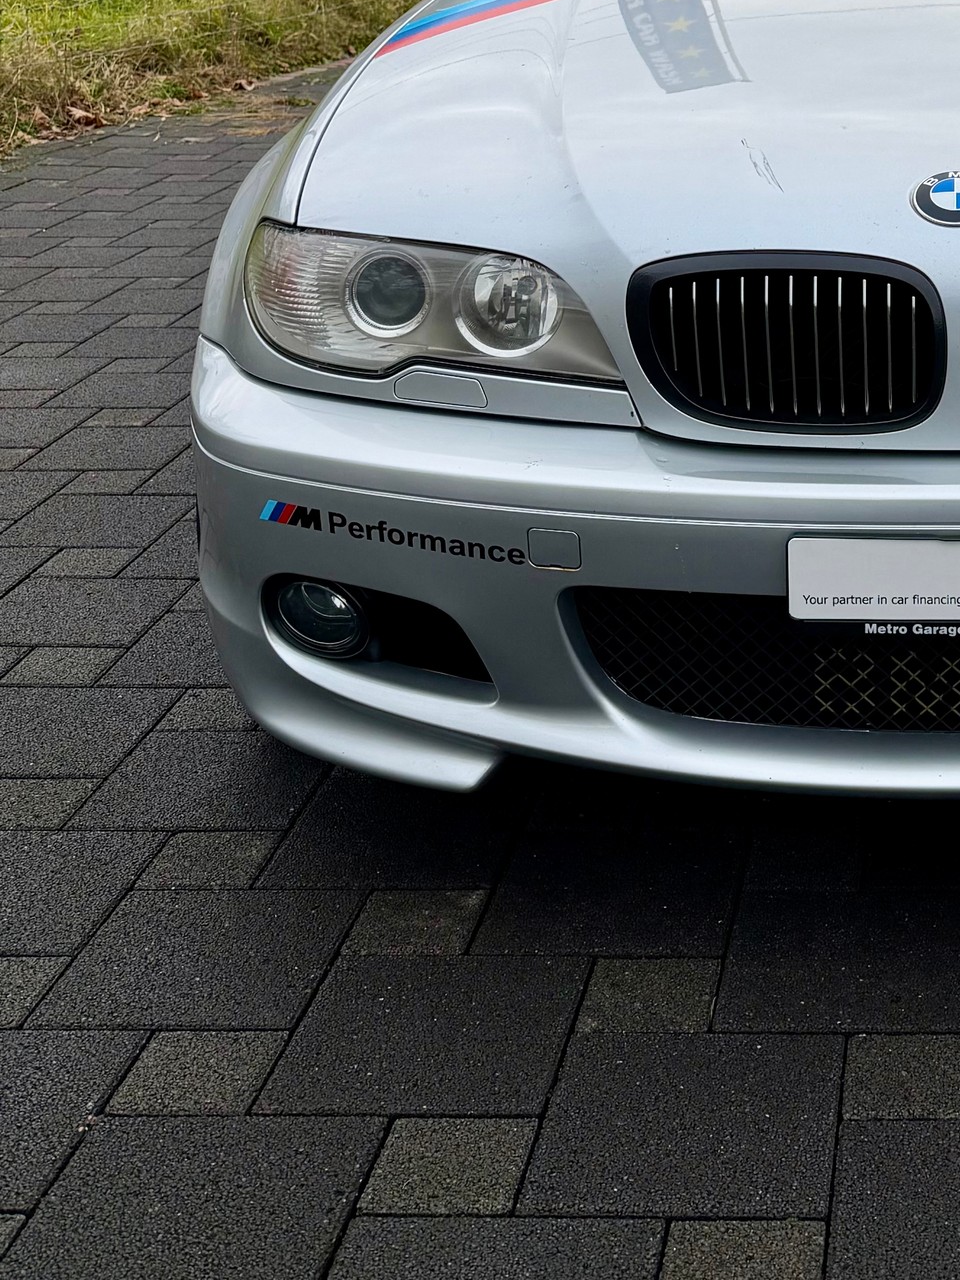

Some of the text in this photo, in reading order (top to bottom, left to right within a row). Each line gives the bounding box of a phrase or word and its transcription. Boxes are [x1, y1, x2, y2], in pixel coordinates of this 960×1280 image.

[328, 511, 526, 565] Performance
[803, 595, 829, 605] Your
[832, 596, 873, 607] partner
[877, 595, 887, 605] in
[891, 597, 908, 605] car
[864, 623, 907, 635] Metro
